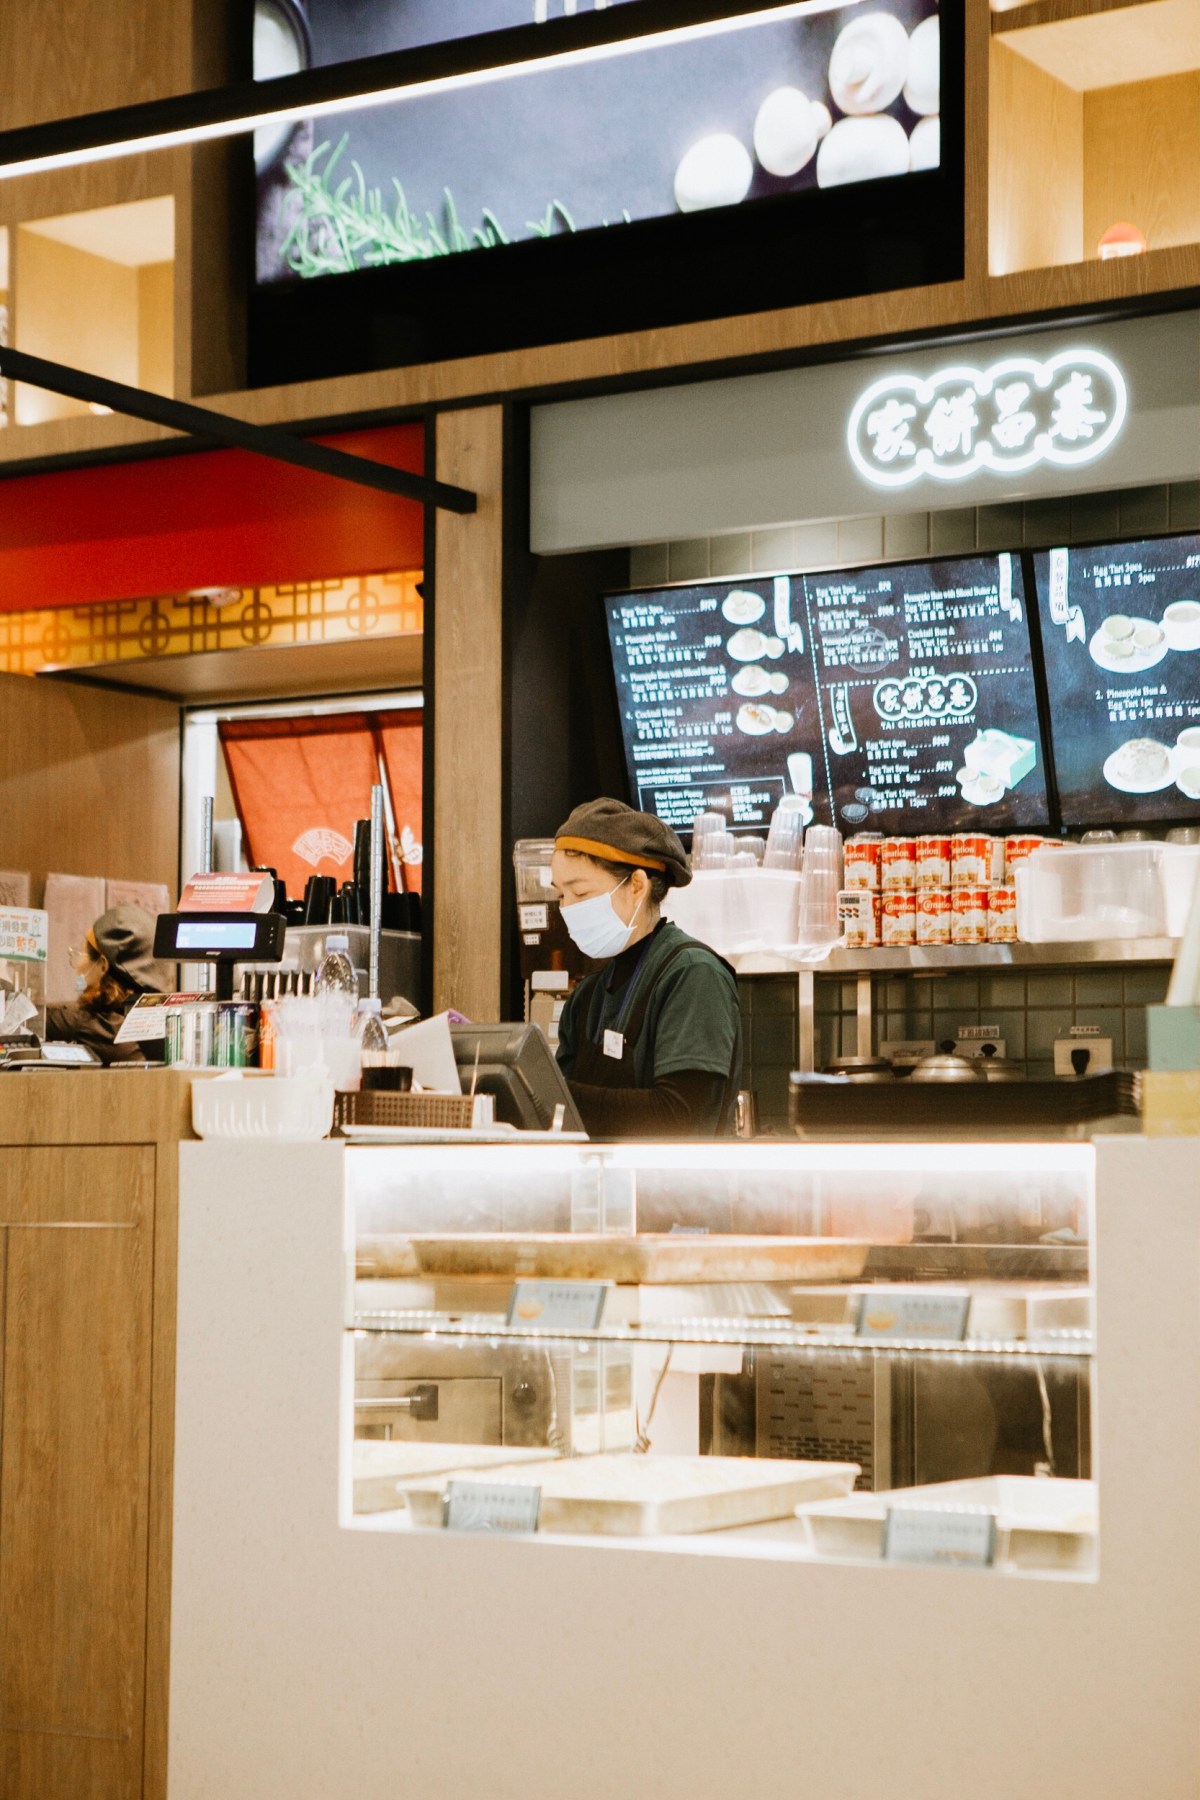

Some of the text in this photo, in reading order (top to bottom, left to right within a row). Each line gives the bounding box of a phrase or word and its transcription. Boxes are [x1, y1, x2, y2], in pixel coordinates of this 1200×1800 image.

[1093, 565, 1108, 576] Egg
[1109, 563, 1123, 574] Tart
[903, 591, 930, 603] Pineapple
[930, 590, 942, 599] Bun
[943, 590, 955, 598] with
[955, 587, 972, 597] Sliced
[624, 633, 655, 644] Pineapple
[655, 632, 669, 641] Bun
[907, 627, 933, 638] Cocktail
[934, 627, 947, 635] Bun
[822, 635, 851, 646] Pineapple
[851, 634, 864, 643] Bun
[657, 670, 669, 678] Bun
[1106, 687, 1141, 699] Pineapple
[1142, 685, 1158, 695] Bun
[1107, 700, 1122, 710] Egg
[1123, 698, 1138, 707] Tart
[634, 709, 661, 718] Cocktail
[661, 707, 675, 716] Bun
[880, 715, 976, 730] TAI CHEONG BAKERY
[865, 741, 878, 750] Egg
[879, 740, 891, 748] Tart
[869, 765, 881, 775] Egg
[881, 765, 894, 773] Tart
[655, 791, 667, 800] Red
[668, 791, 683, 799] Bean
[871, 790, 884, 800] Egg
[884, 789, 897, 798] Tart
[669, 799, 689, 808] Lemon
[672, 808, 692, 816] Lemon
